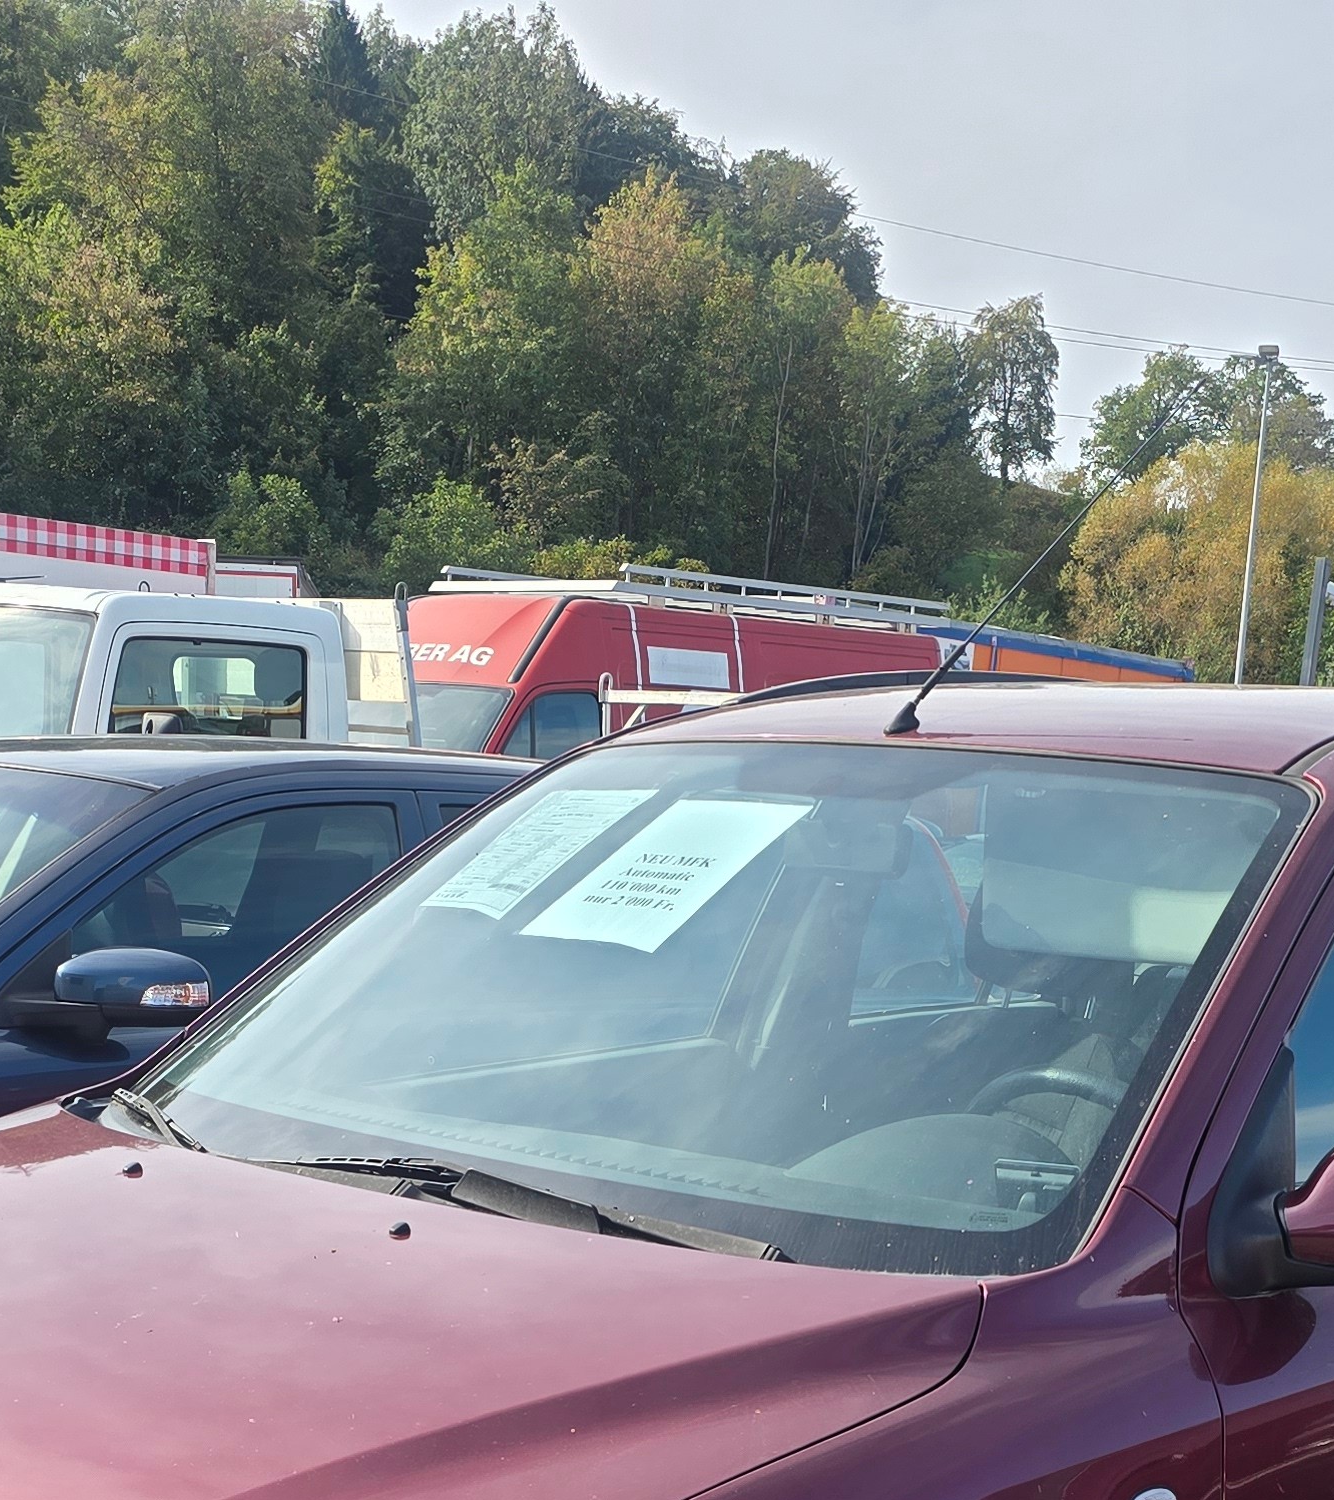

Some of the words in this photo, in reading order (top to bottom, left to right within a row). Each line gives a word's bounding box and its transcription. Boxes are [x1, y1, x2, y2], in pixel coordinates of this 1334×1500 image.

[447, 644, 495, 666] AG
[635, 853, 675, 866] NEU
[672, 856, 718, 868] MFK
[619, 866, 695, 882] Automatic
[655, 884, 682, 896] km
[582, 895, 612, 905] nur
[651, 899, 675, 911] Fr.
